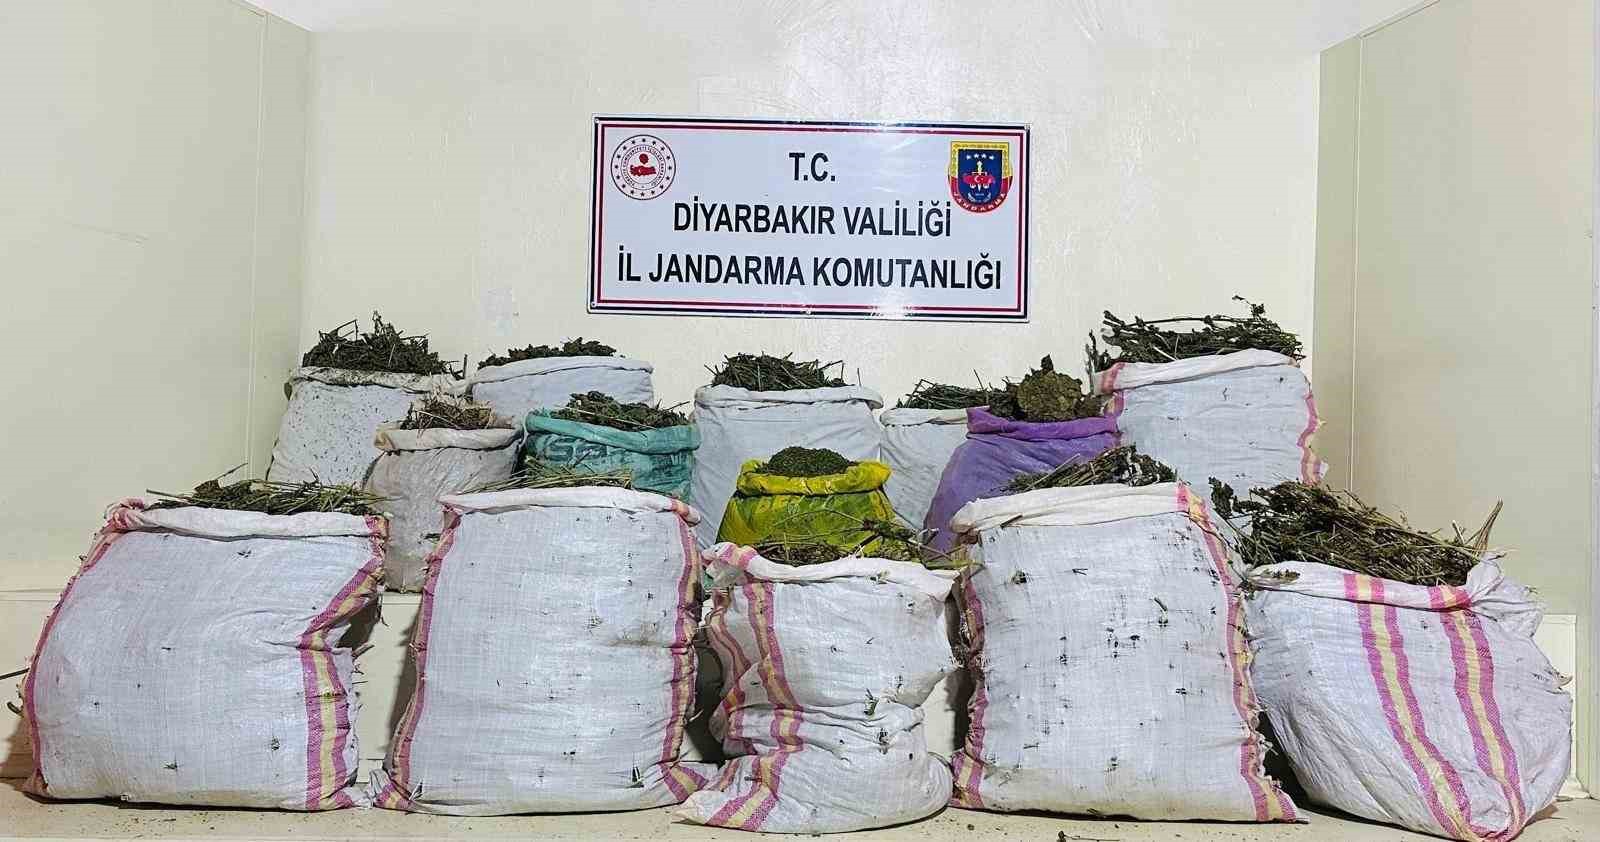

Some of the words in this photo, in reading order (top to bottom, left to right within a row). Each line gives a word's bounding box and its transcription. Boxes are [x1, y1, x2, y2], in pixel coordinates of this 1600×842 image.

[788, 152, 836, 182] T.C.
[673, 195, 836, 235] DİYARBAKIR
[842, 199, 952, 237] VALİLİĞİ
[618, 244, 641, 282] İL
[648, 253, 806, 287] JANDARMA
[813, 252, 1001, 290] KOMUTANLIĞI
